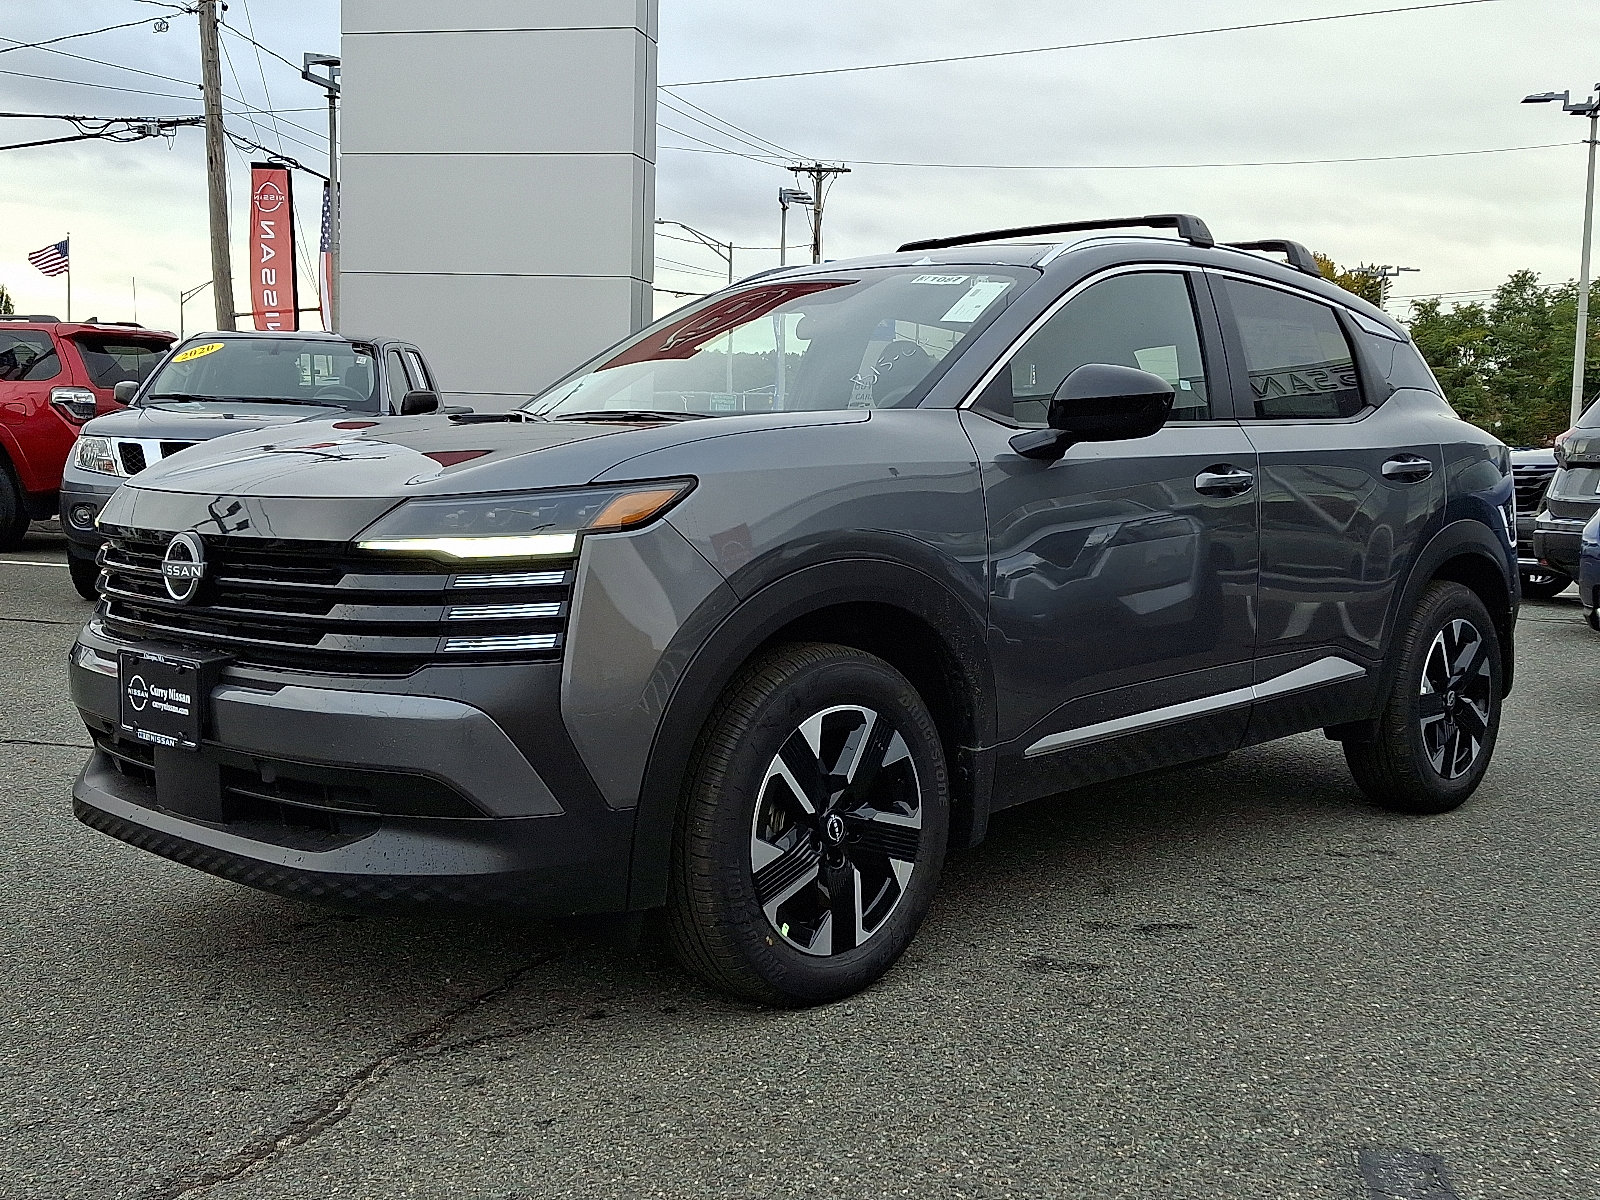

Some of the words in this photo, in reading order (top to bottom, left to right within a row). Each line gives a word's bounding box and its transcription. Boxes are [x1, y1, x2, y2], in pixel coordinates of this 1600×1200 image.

[181, 345, 215, 360] 2020
[161, 564, 201, 577] ISSAN
[127, 687, 149, 698] NISSAN
[149, 684, 168, 701] Curry
[168, 688, 191, 704] Nissan
